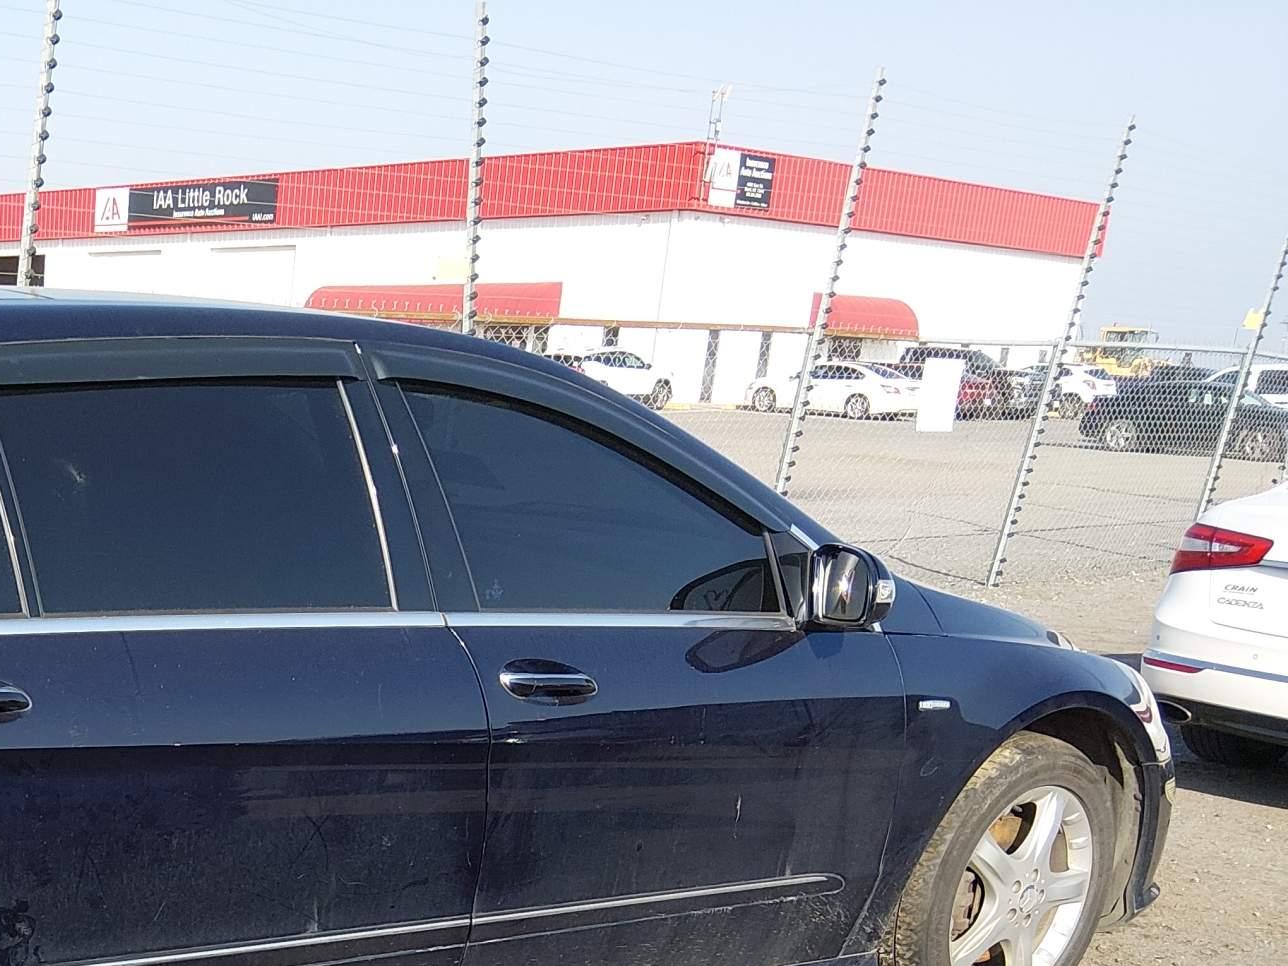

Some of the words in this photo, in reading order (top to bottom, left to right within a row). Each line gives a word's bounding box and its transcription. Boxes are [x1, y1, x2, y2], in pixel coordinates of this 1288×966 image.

[153, 189, 173, 210] IAA
[178, 187, 210, 208] Little
[214, 184, 248, 206] Rock
[1224, 584, 1259, 593] CRAIN
